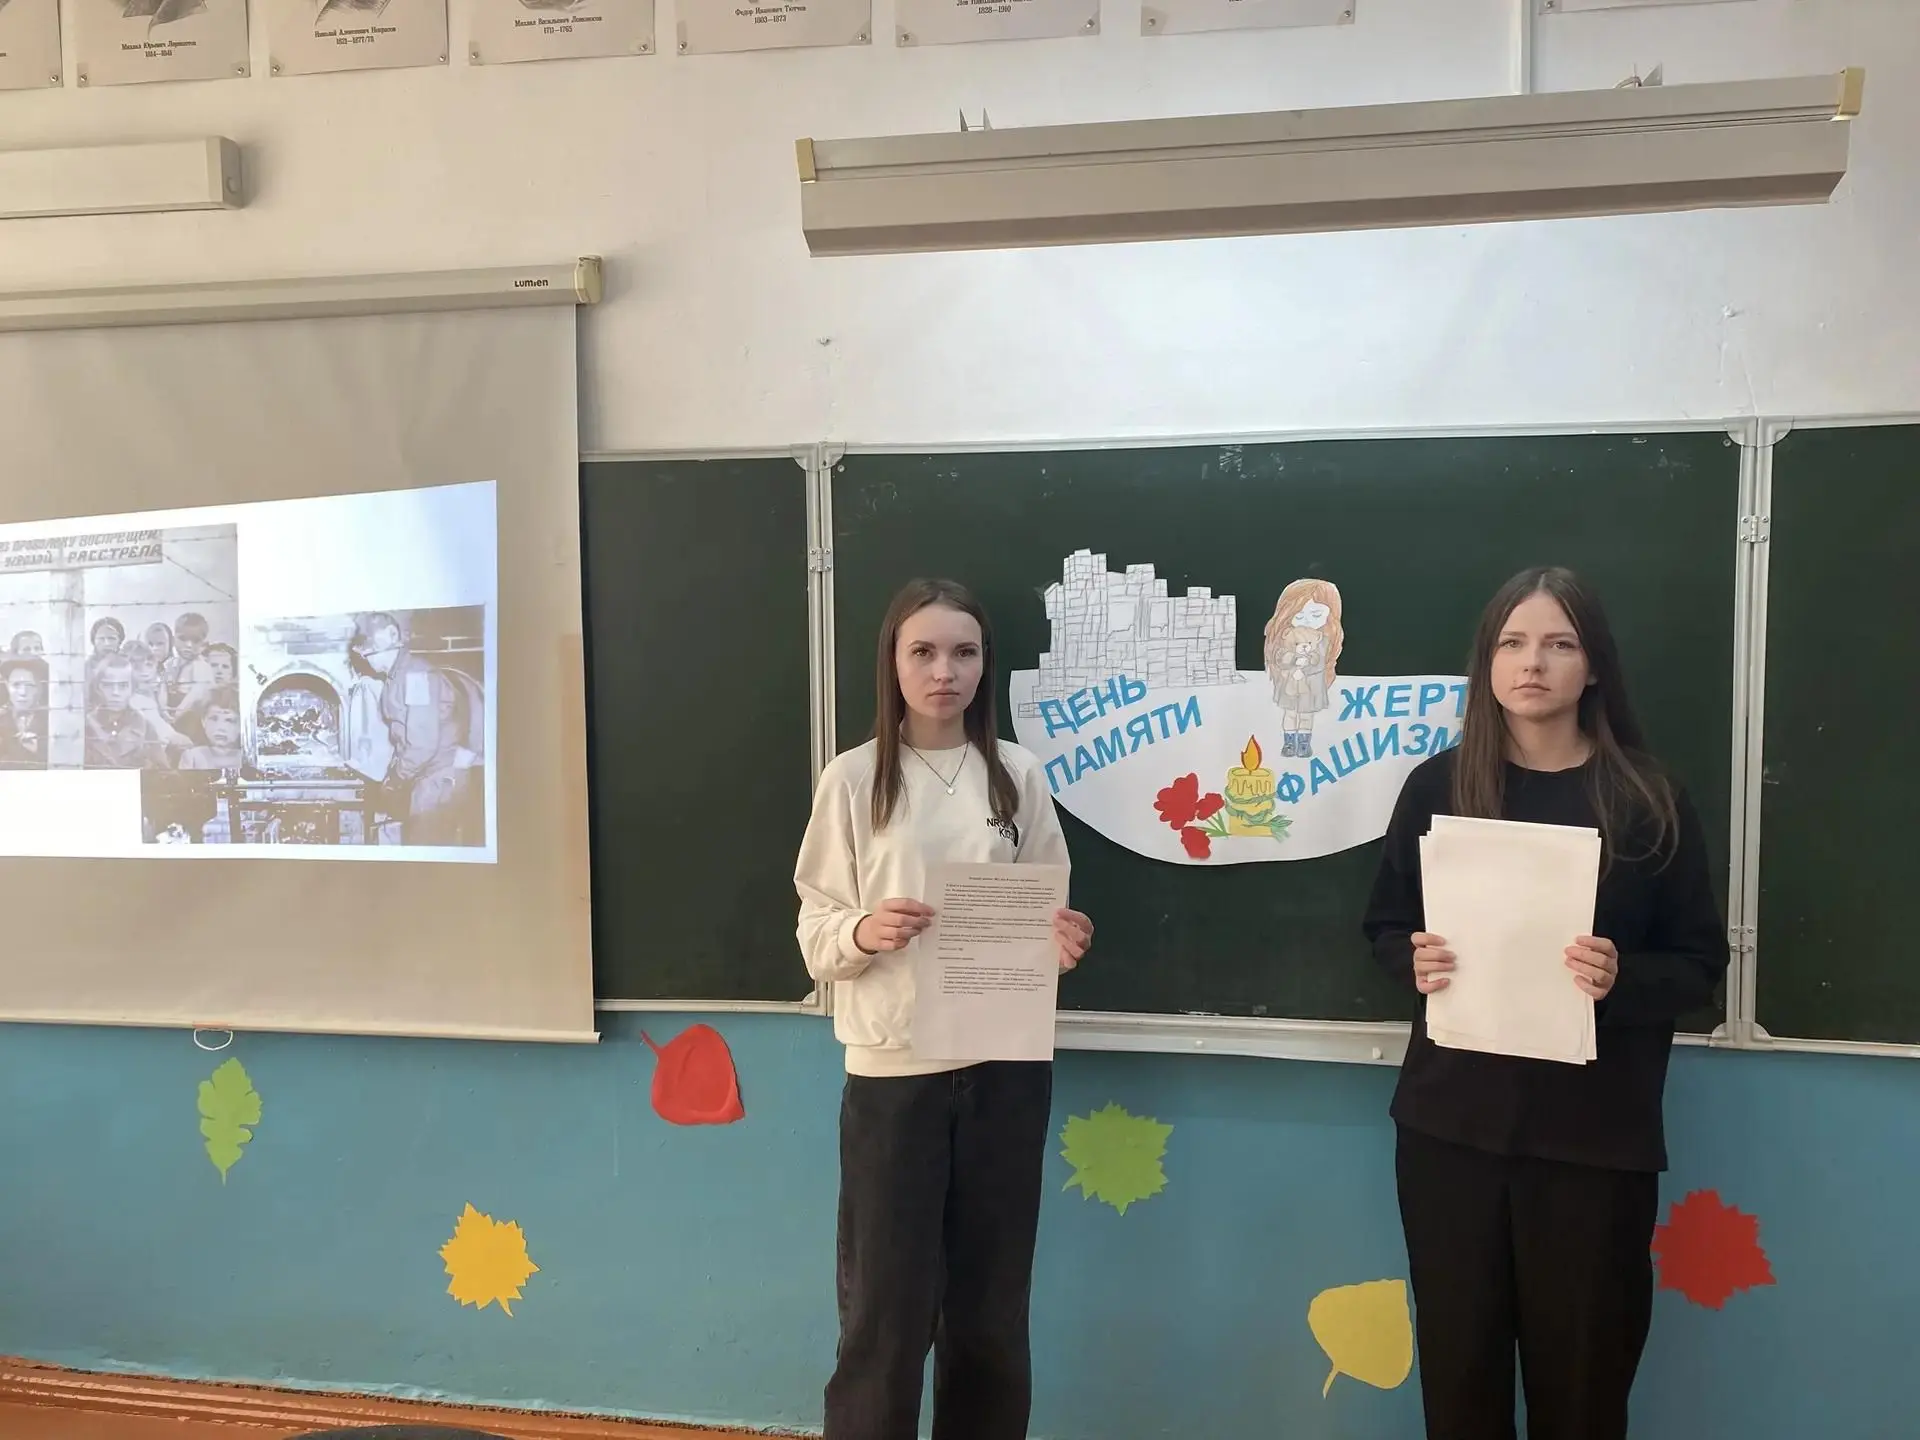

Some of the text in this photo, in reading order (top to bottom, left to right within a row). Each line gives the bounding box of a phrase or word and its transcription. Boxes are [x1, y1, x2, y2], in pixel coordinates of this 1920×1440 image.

[68, 543, 163, 563] РАССТРЕЛА
[1039, 674, 1147, 739] ДЕНЬ
[1044, 695, 1202, 795] ПАМЯТИ
